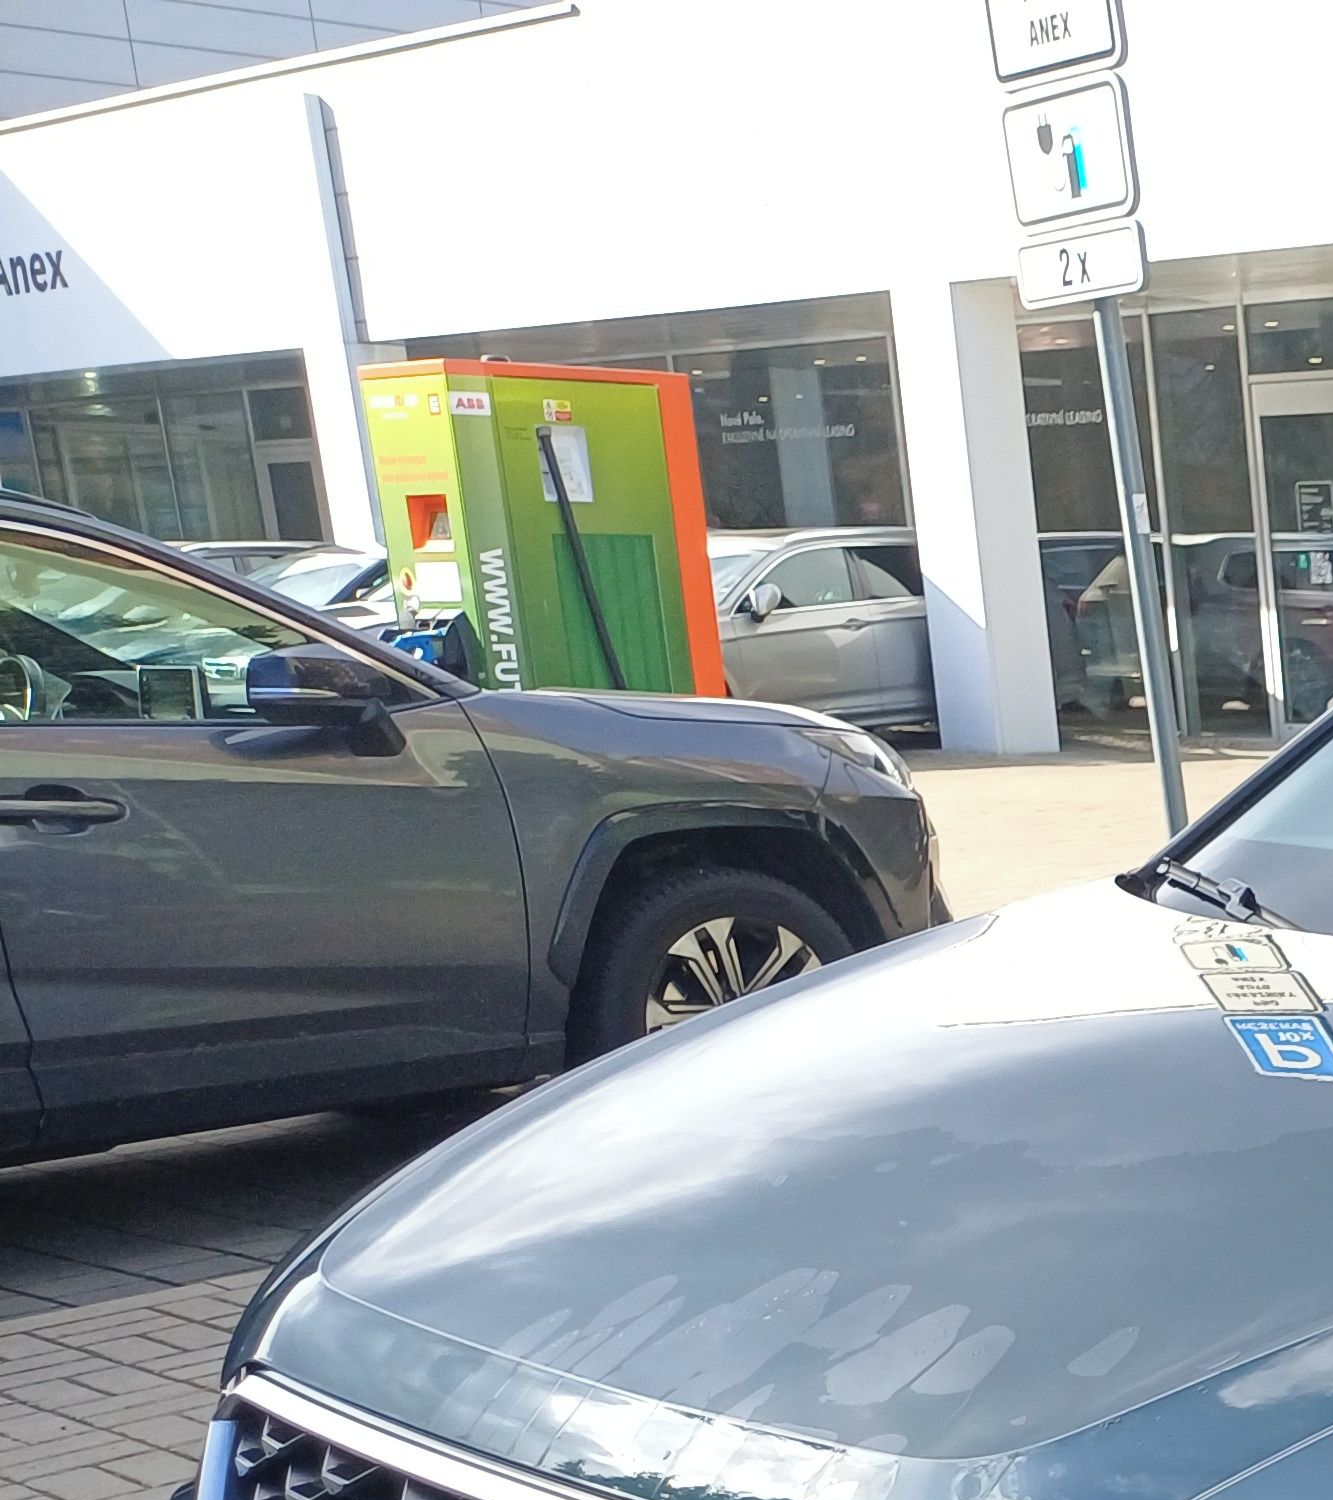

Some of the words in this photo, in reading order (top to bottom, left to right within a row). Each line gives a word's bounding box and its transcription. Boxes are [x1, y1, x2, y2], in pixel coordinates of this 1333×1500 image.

[1029, 11, 1072, 47] ANEX
[1059, 248, 1073, 286] 2
[455, 397, 486, 410] ABB
